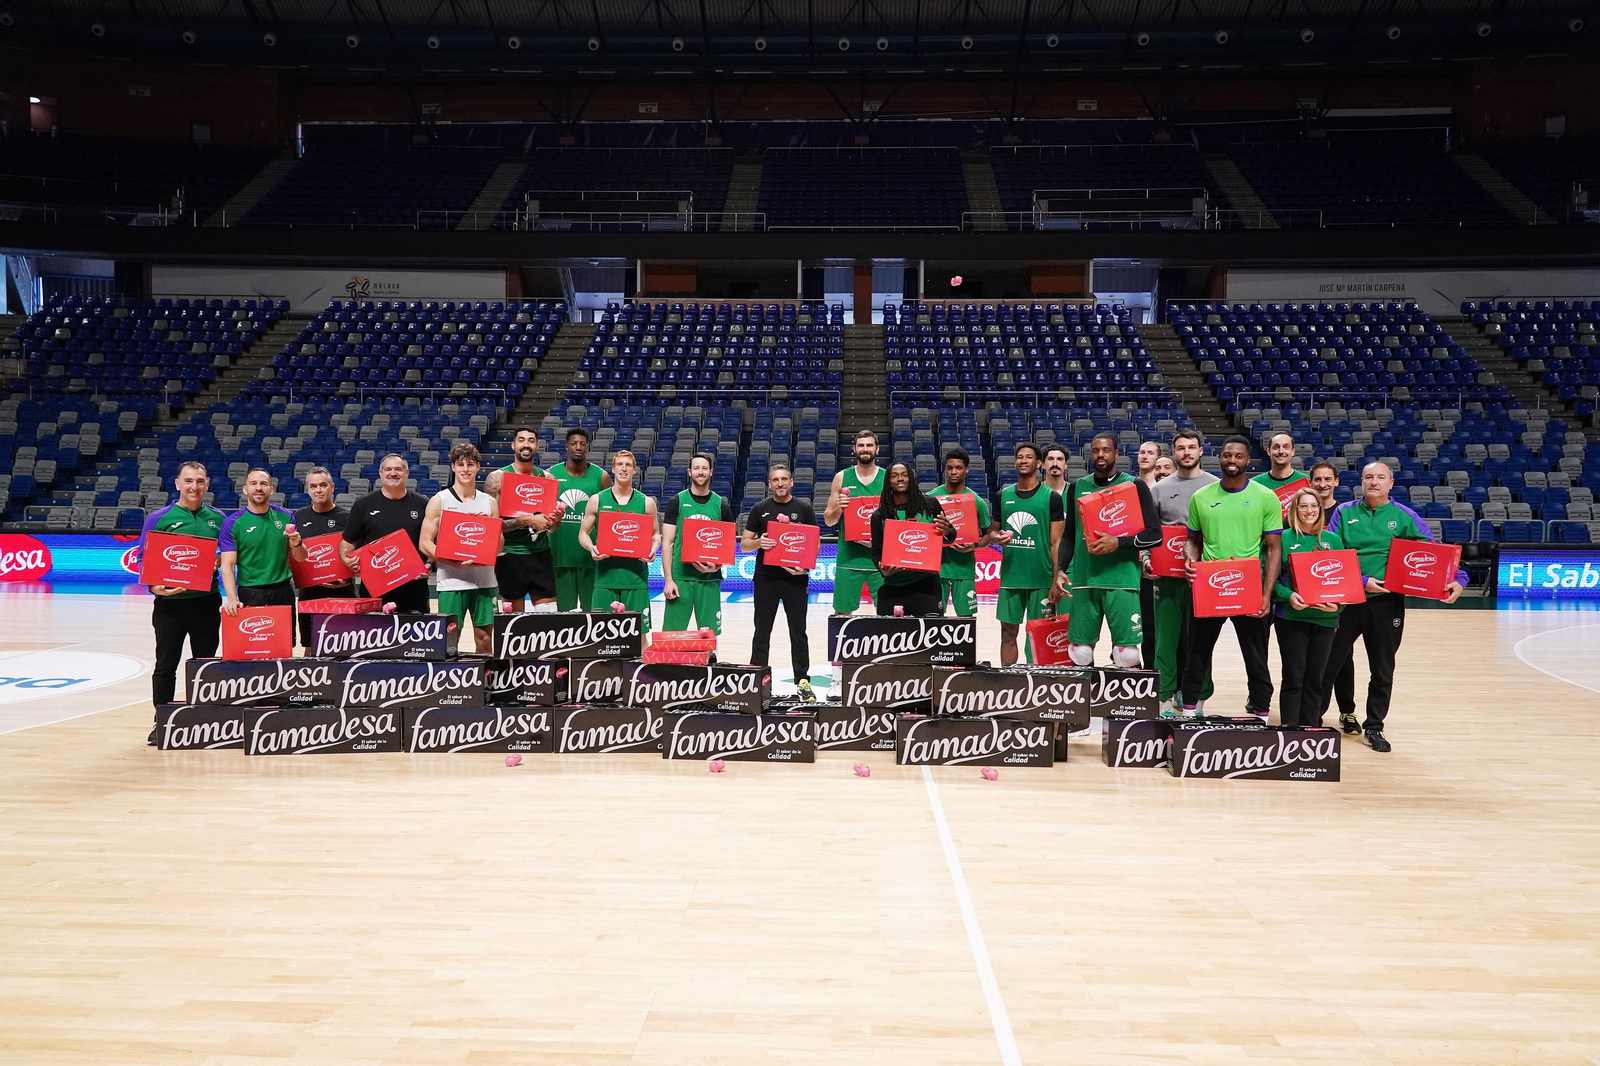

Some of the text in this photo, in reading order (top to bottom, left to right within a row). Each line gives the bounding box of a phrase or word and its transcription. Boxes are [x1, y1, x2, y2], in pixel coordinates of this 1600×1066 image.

[1319, 283, 1334, 292] JOSÉ
[1347, 283, 1372, 292] MARTÍN
[1374, 284, 1405, 292] CARPENA
[1509, 562, 1600, 588] El Sab
[316, 613, 443, 659] famadesa
[500, 613, 639, 659] famadesa
[834, 617, 973, 662] famadesa
[191, 660, 332, 705] famadesa
[341, 661, 482, 708] famadesa
[517, 694, 536, 702] Calidad
[628, 662, 758, 709] famadesa
[938, 671, 1085, 717] famadesa
[410, 707, 550, 753] famadesa
[718, 703, 740, 711] Calidad
[1039, 712, 1064, 720] Calidad
[1111, 708, 1136, 716] Calidad
[250, 708, 397, 755] famadesa
[668, 713, 811, 760] famadesa
[902, 717, 1049, 765] famadesa
[1180, 729, 1338, 779] famadesa
[1290, 771, 1316, 779] Calidad
